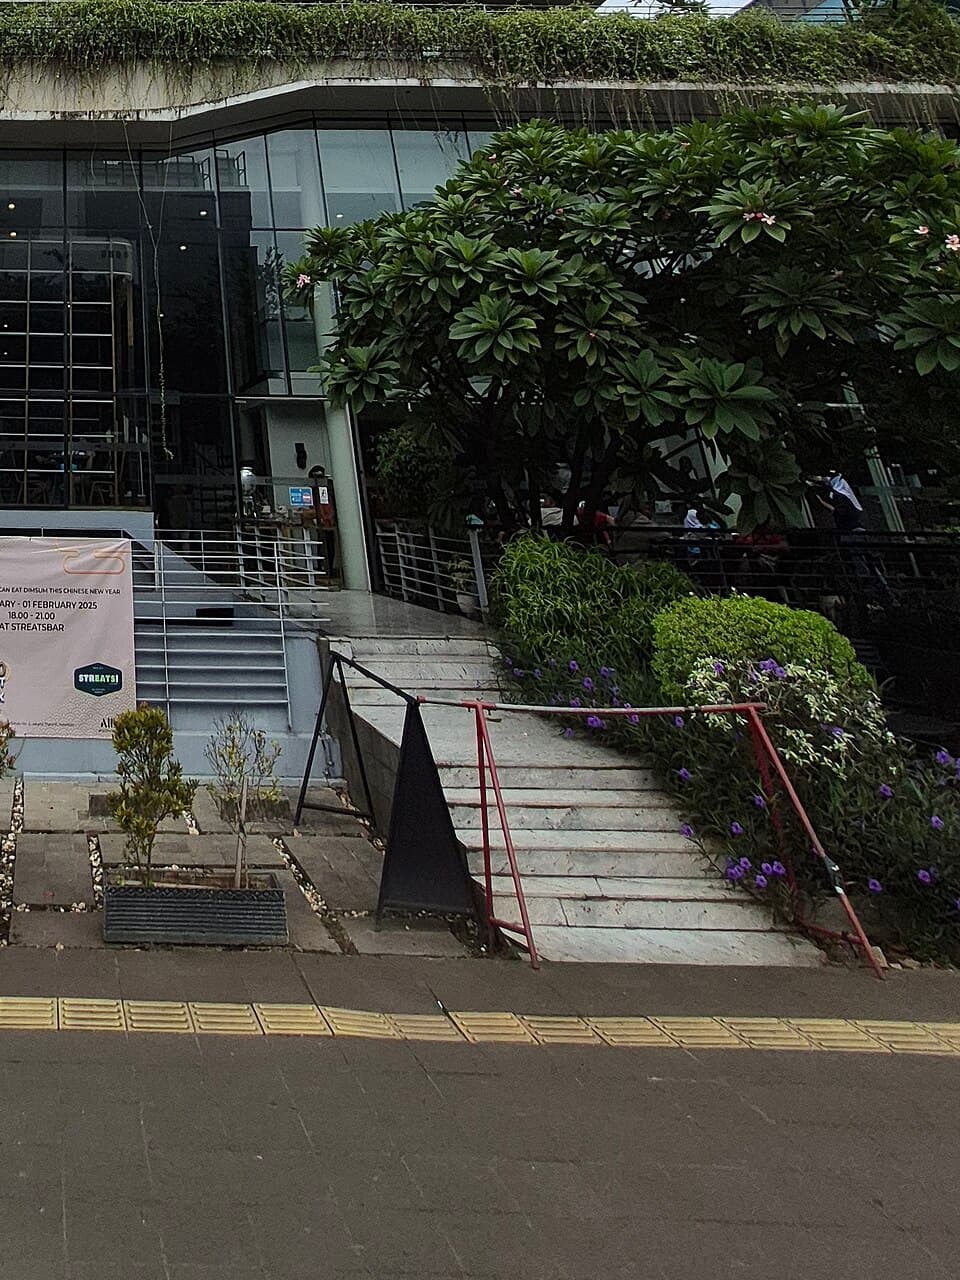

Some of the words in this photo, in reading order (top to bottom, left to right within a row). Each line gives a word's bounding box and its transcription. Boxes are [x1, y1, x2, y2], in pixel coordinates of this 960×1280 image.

[22, 600, 31, 608] 01
[33, 601, 77, 609] FEBRUARY
[78, 601, 98, 609] 2025
[8, 611, 28, 620] 18.00
[35, 612, 55, 620] 21.00
[0, 623, 10, 631] AT
[11, 623, 64, 632] STREATSBAR
